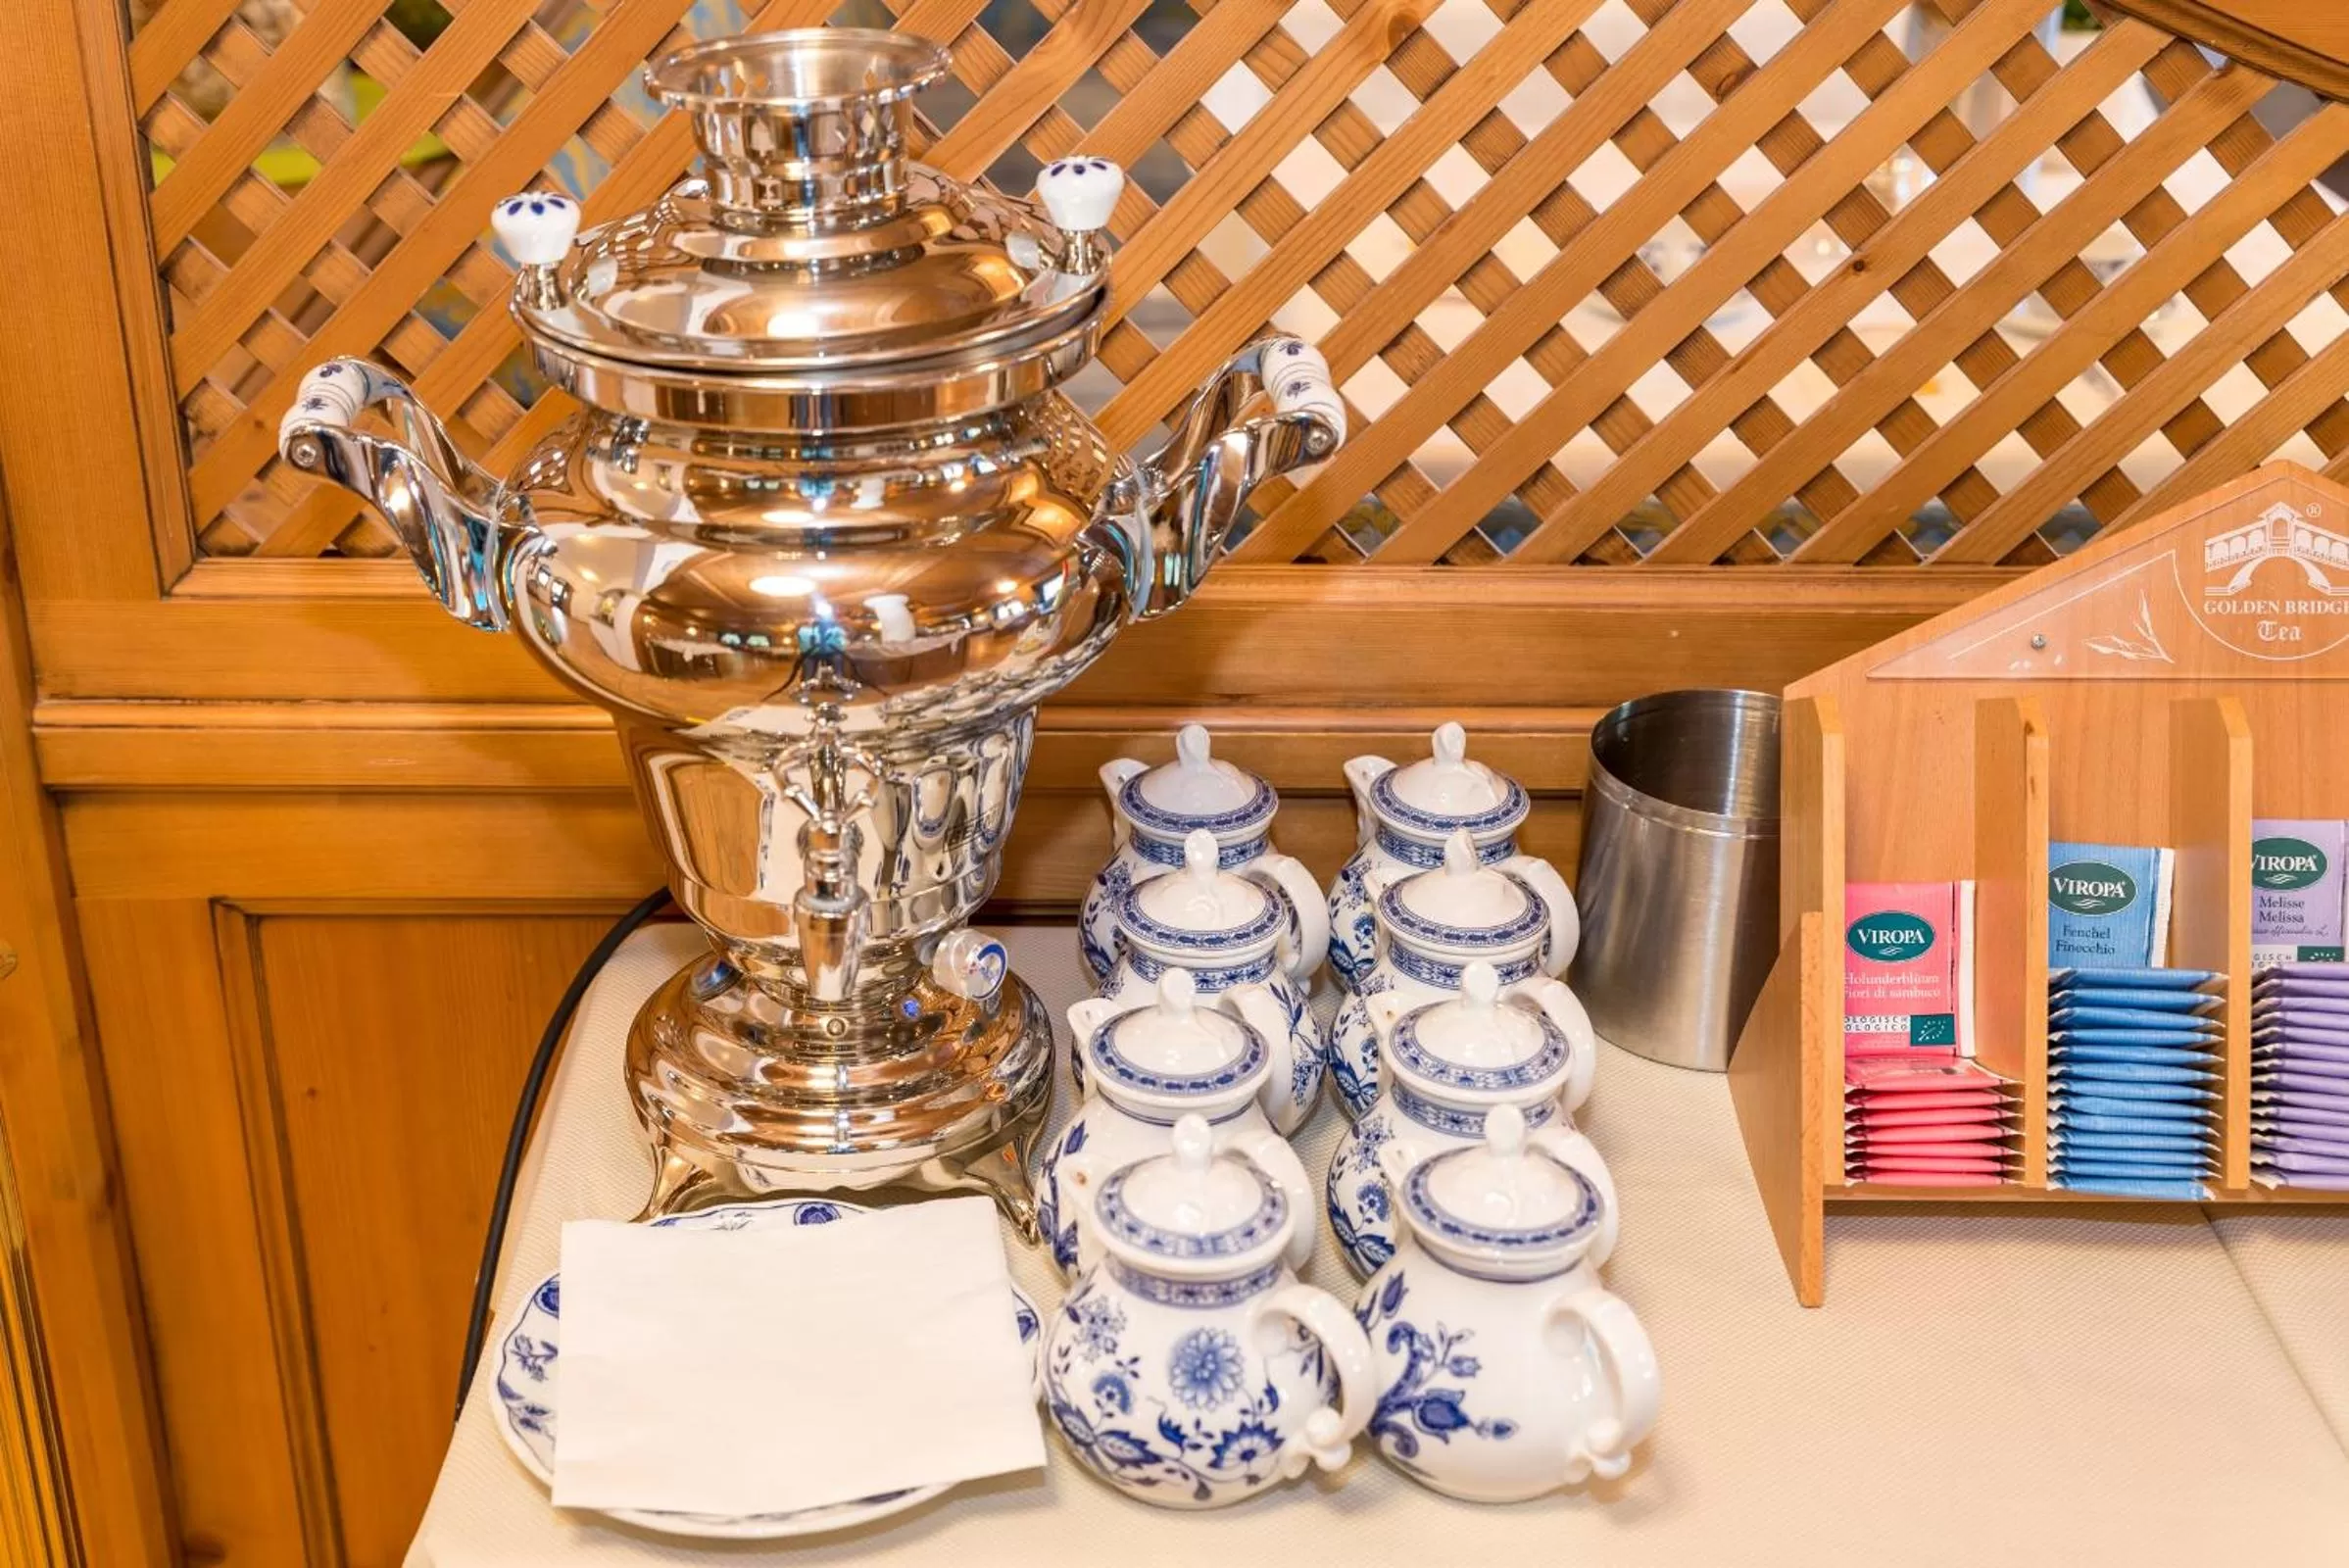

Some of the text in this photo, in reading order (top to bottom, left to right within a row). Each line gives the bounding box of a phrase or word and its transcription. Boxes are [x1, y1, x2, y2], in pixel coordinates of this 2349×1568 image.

[2204, 600, 2280, 615] GOLDEN
[2256, 619, 2302, 642] Tea
[2053, 877, 2127, 899] VIROPA
[2259, 896, 2305, 908] Melisse
[2259, 910, 2305, 923] Melissa
[1857, 929, 1926, 944] VIROPA
[2063, 924, 2111, 939] Fenchel
[2055, 939, 2115, 956] Finocchio
[1874, 987, 1884, 998] di
